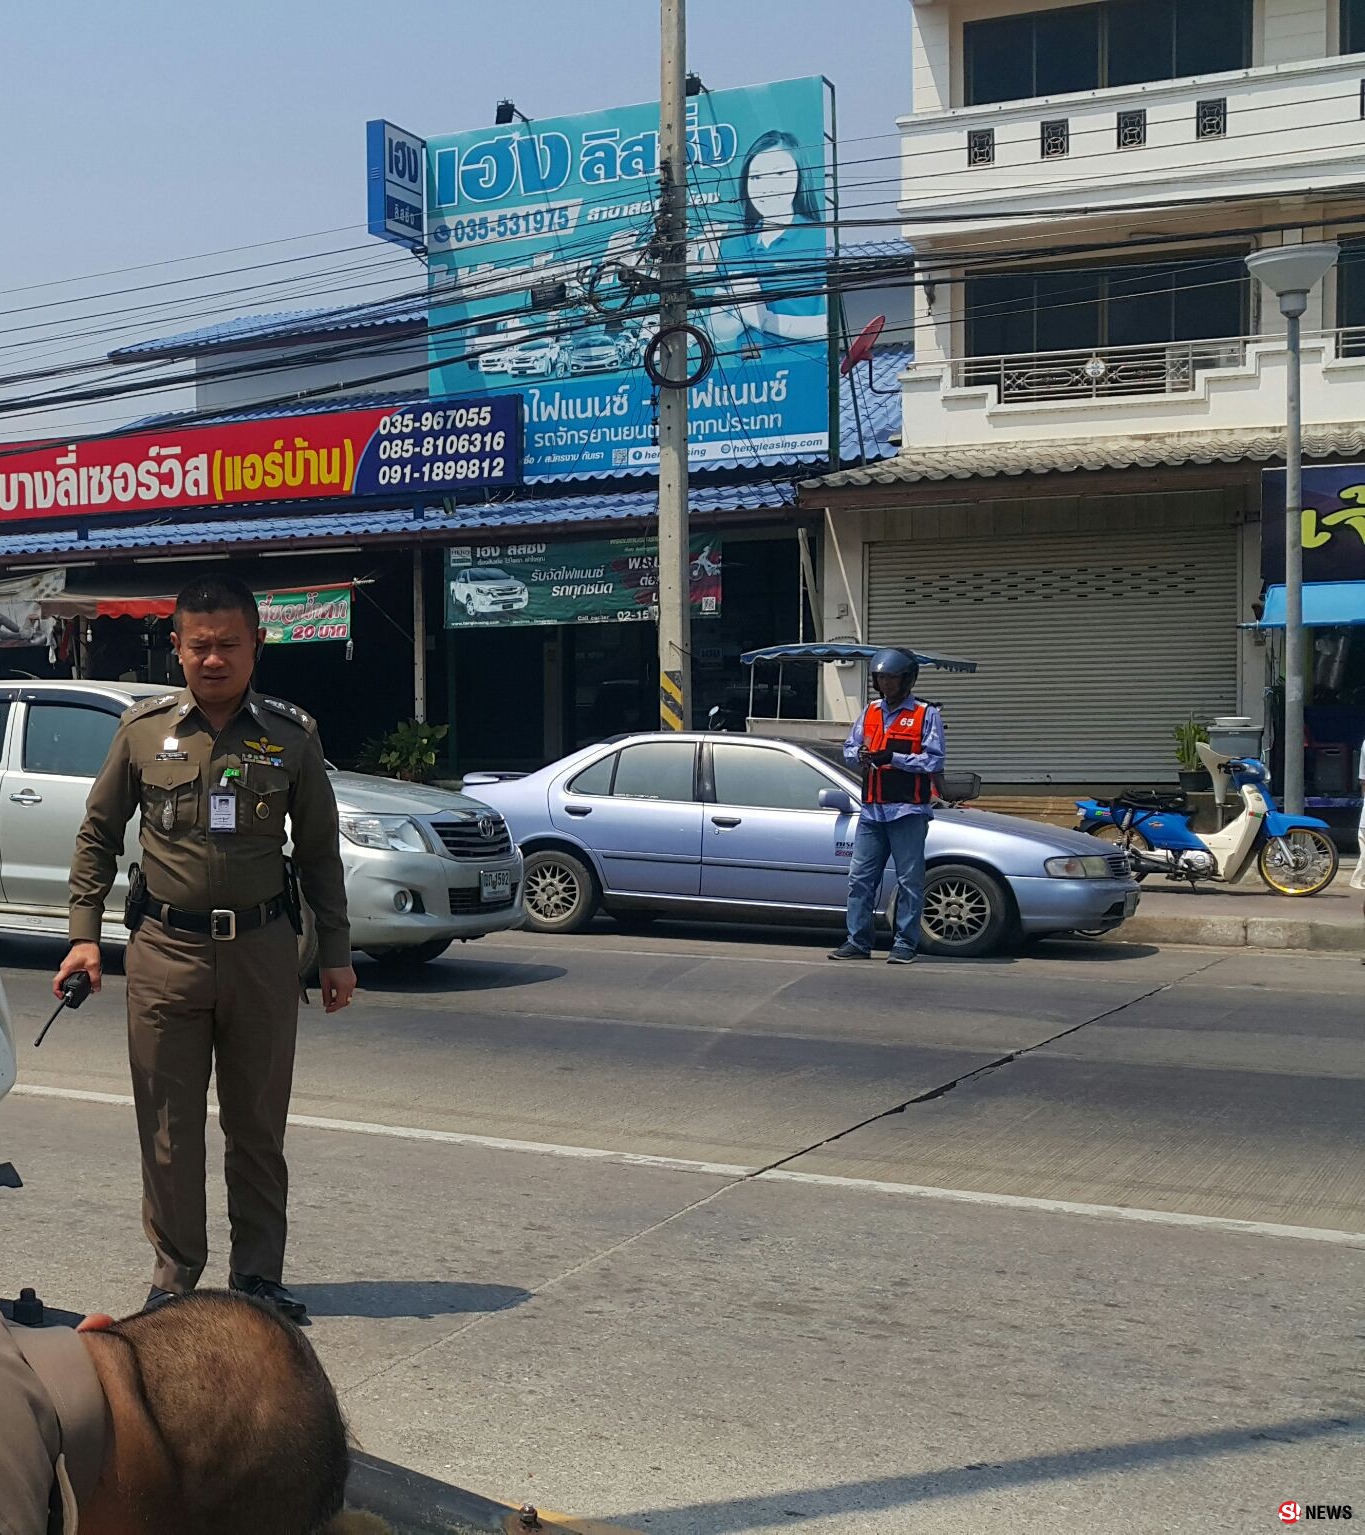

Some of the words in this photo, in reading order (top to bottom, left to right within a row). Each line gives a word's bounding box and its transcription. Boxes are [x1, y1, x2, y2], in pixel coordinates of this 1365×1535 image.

[388, 137, 418, 183] เฮง
[436, 132, 571, 208] เฮง
[454, 207, 569, 243] 035-531975
[379, 406, 492, 435] 035-967055
[379, 430, 506, 460] 085-8106316
[733, 438, 823, 453] hengleasing.com
[378, 456, 505, 485] 091-1899812
[291, 625, 316, 640] 20
[318, 624, 348, 638] บาท
